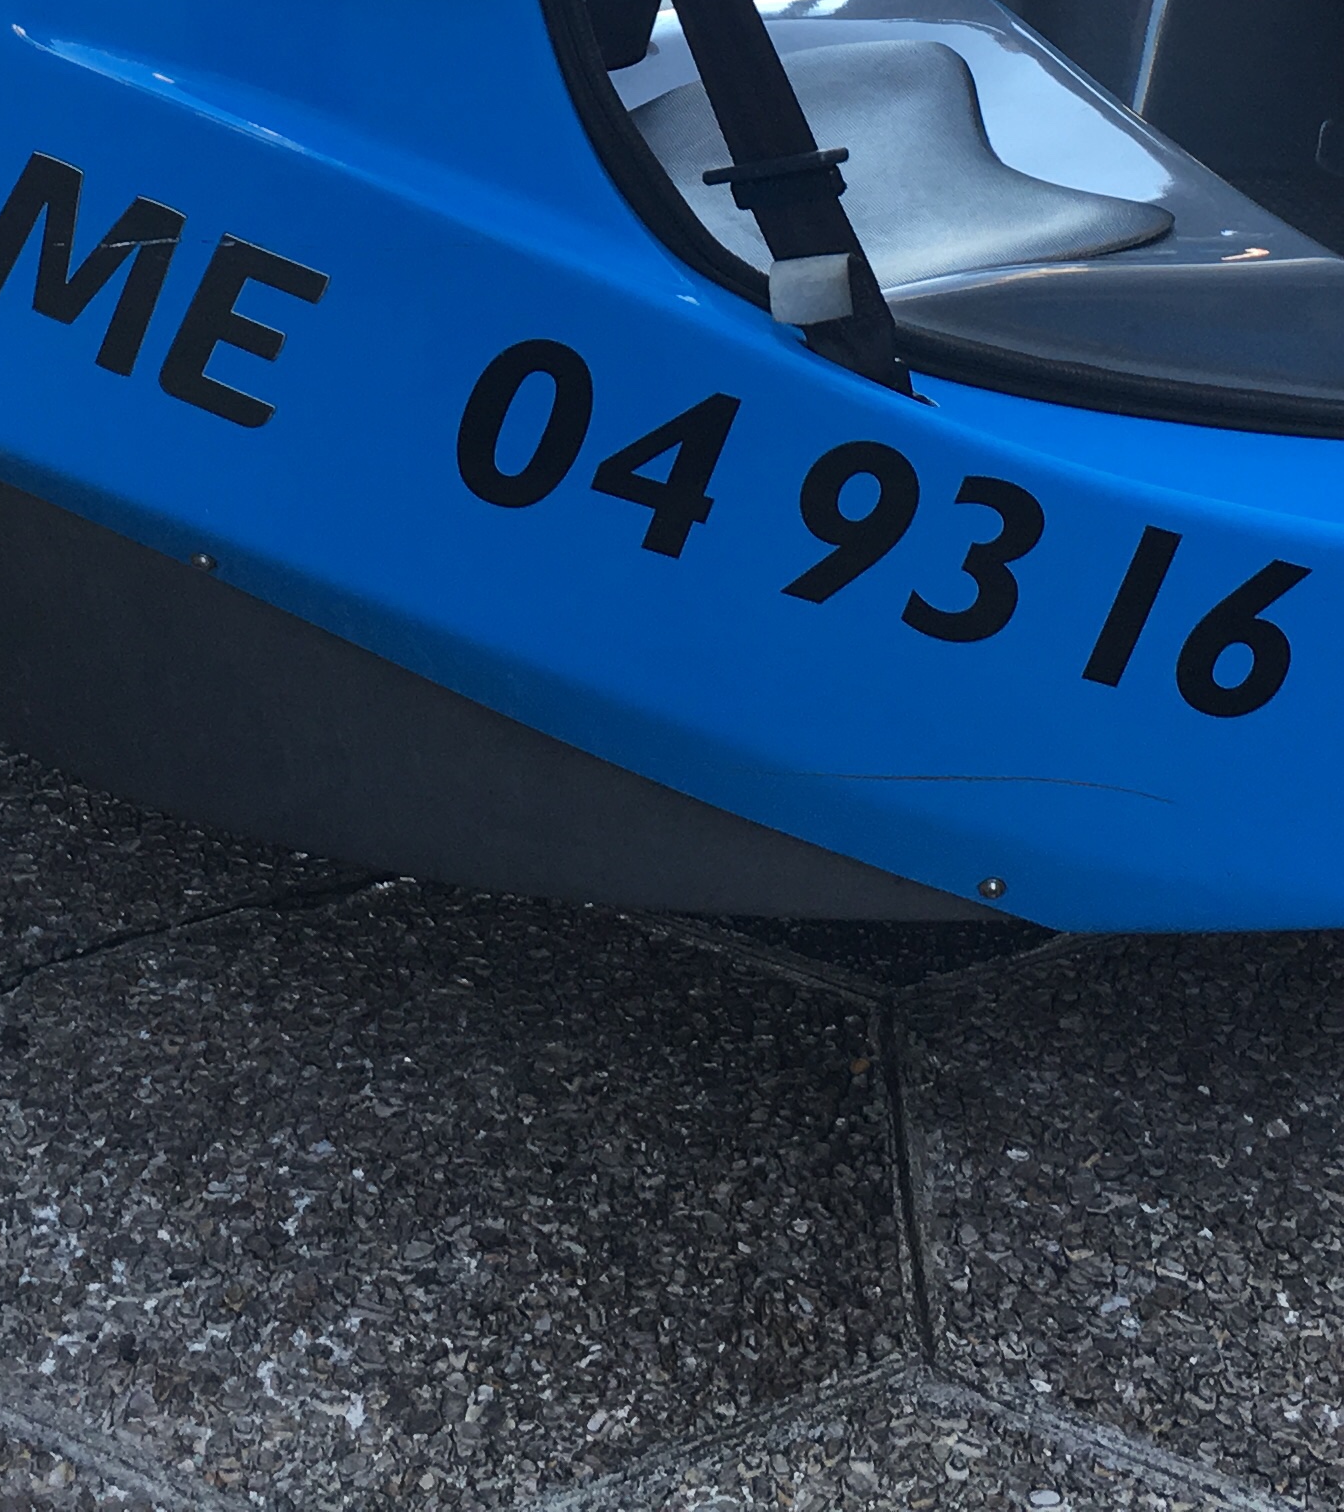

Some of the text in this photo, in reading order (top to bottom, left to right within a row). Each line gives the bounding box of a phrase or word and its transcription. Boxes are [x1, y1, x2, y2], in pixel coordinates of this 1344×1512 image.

[454, 337, 742, 560] 04
[780, 439, 1047, 644] 93
[1080, 524, 1314, 719] 16
